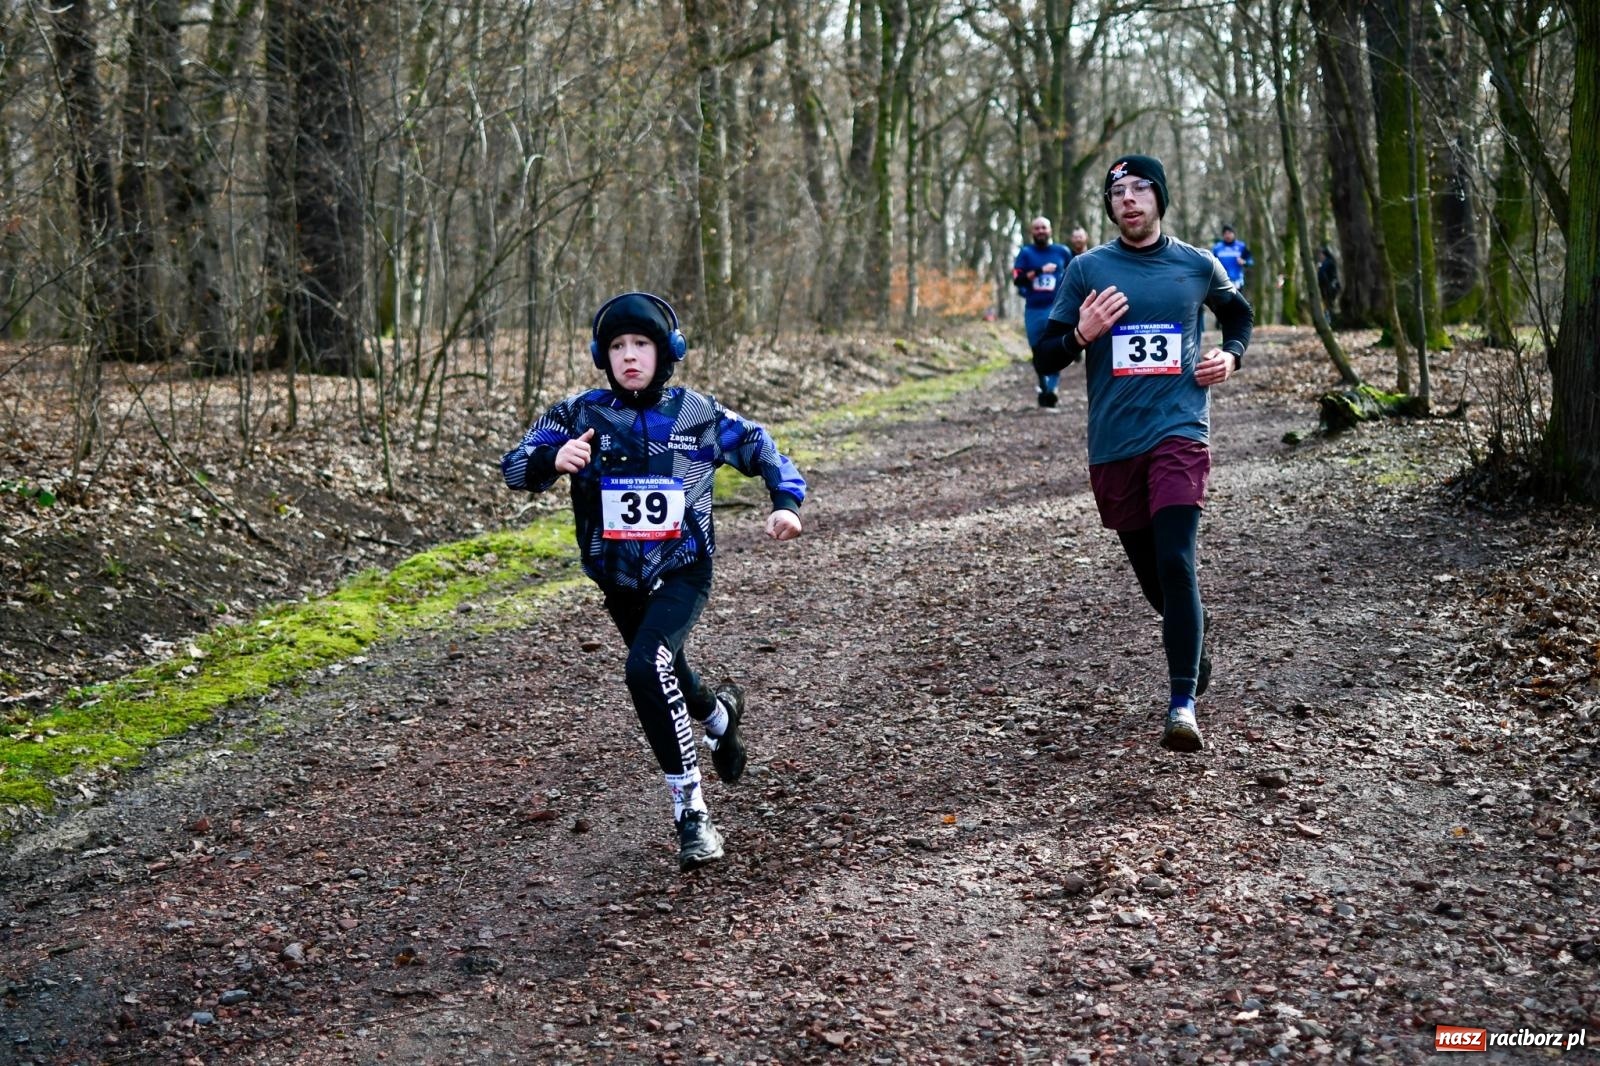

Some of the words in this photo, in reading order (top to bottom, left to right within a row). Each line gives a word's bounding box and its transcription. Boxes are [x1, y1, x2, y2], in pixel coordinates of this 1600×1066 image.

[1128, 335, 1168, 362] 33
[667, 442, 698, 451] Racibórz
[669, 433, 697, 444] Zapasy
[620, 492, 668, 525] 39
